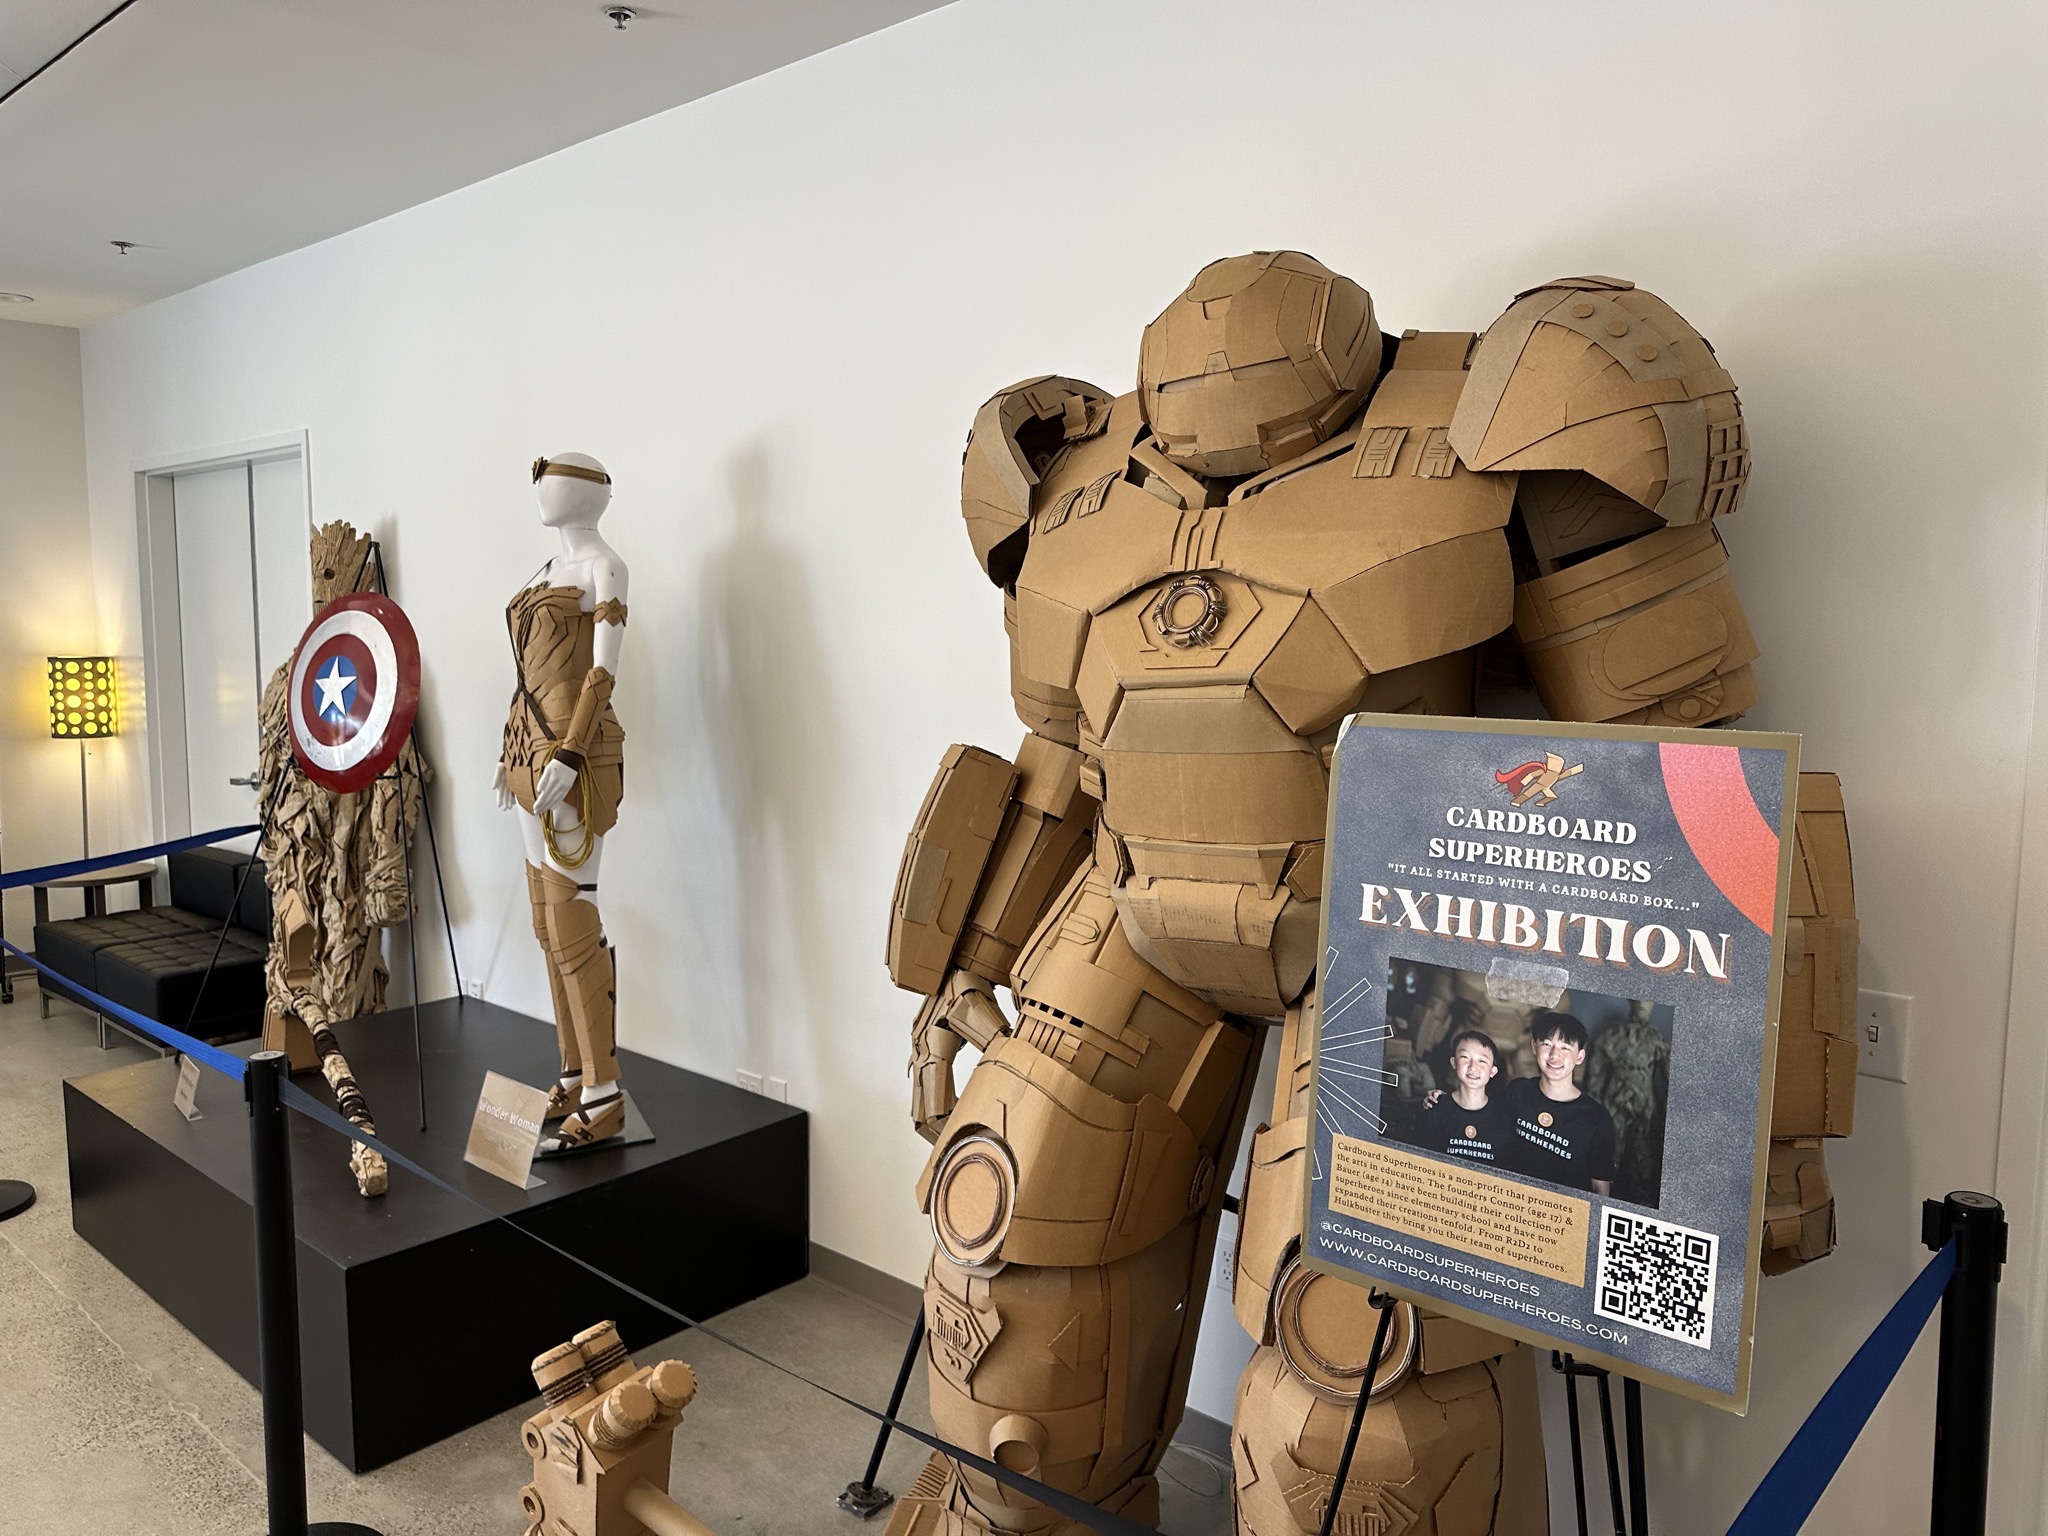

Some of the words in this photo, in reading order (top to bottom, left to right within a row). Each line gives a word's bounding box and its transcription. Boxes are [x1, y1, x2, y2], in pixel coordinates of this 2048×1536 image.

[1428, 837, 1652, 884] SUPERHEROES
[1446, 806, 1638, 846] CARDBOARD
[1387, 862, 1407, 876] "IT
[1409, 865, 1433, 879] ALL
[1436, 868, 1495, 886] STARTED
[1498, 875, 1535, 892] WITH
[1538, 881, 1549, 893] A
[1551, 882, 1639, 906] CARDBOARD
[1642, 895, 1701, 912] BOX..."
[1358, 882, 1732, 980] EXHIBITION
[478, 1098, 509, 1121] Wonder
[509, 1112, 541, 1135] Woman
[1449, 1138, 1492, 1150] CARDBOARD
[1516, 1118, 1570, 1147] CARDBOARD
[1335, 1175, 1384, 1195] superheroes
[1386, 1190, 1408, 1202] since
[1410, 1197, 1459, 1218] elementary
[1461, 1212, 1491, 1227] school
[1493, 1222, 1511, 1232] and
[1513, 1225, 1535, 1239] have
[1537, 1235, 1558, 1245] now
[1336, 1163, 1360, 1177] Bauer
[1362, 1170, 1379, 1182] (age
[1395, 1180, 1415, 1193] have
[1417, 1186, 1437, 1199] been
[1440, 1192, 1477, 1212] building
[1480, 1205, 1502, 1217] their
[1504, 1213, 1551, 1232] collection
[1554, 1227, 1565, 1235] of
[1337, 1141, 1381, 1160] Cardboard
[1382, 1154, 1436, 1176] Superheroes
[1438, 1169, 1445, 1178] is
[1455, 1176, 1503, 1195] non-profit
[1506, 1188, 1525, 1201] that
[1527, 1195, 1572, 1213] promotes
[1337, 1152, 1350, 1162] the
[1352, 1158, 1367, 1167] arts
[1369, 1161, 1378, 1171] in
[1380, 1166, 1424, 1184] education.
[1427, 1178, 1445, 1190] The
[1447, 1183, 1487, 1202] founders
[1489, 1196, 1525, 1212] Connor
[1527, 1206, 1547, 1218] (age
[1565, 1216, 1573, 1226] &
[1334, 1186, 1374, 1203] expanded
[1376, 1198, 1397, 1210] their
[1398, 1205, 1438, 1222] creations
[1440, 1217, 1475, 1234] tenfold.
[1478, 1227, 1503, 1242] From
[1533, 1245, 1543, 1253] to
[1334, 1195, 1380, 1216] Hulkbuster
[1382, 1211, 1401, 1224] they
[1402, 1216, 1425, 1231] bring
[1427, 1225, 1443, 1236] you
[1446, 1230, 1468, 1243] their
[1469, 1238, 1492, 1251] team
[1494, 1246, 1505, 1254] of
[1506, 1249, 1567, 1273] superheroes.
[1319, 1236, 1629, 1345] WWW.CARDBOARDSUPERHEROES.COM
[1320, 1220, 1541, 1297] @CARDBOARDSUPERHEROES
